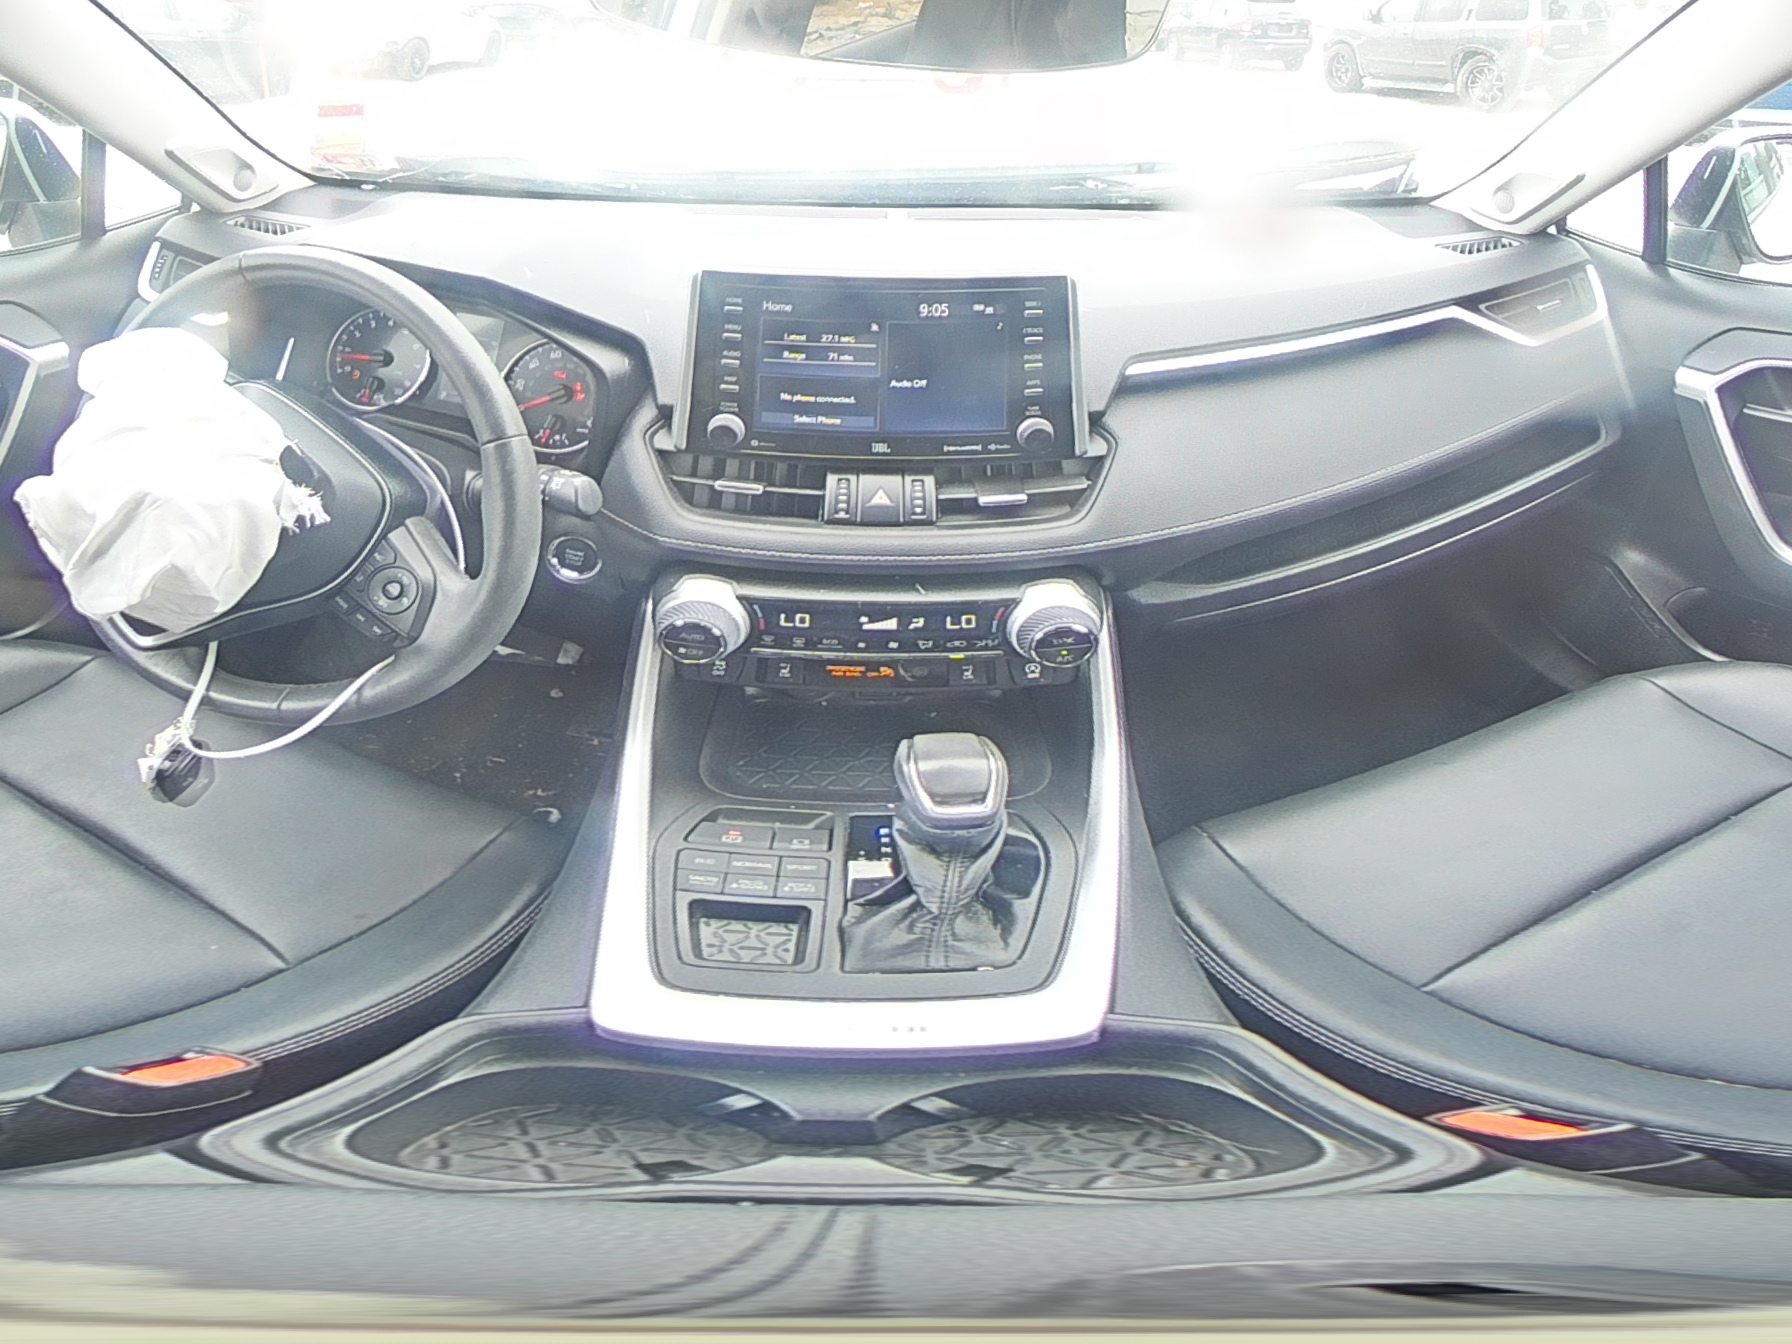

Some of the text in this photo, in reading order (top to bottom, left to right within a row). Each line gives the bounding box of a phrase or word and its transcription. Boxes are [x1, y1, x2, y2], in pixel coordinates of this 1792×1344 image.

[763, 300, 793, 313] Home
[918, 303, 950, 317] 9:05
[820, 334, 840, 343] 27.1
[550, 350, 562, 359] 60
[529, 358, 540, 369] 40
[889, 379, 928, 389] Audio Off
[779, 393, 857, 404] No phone connected.
[793, 415, 842, 425] Select Phone
[871, 442, 891, 453] JBL
[780, 613, 810, 628] LO
[946, 615, 976, 629] LO
